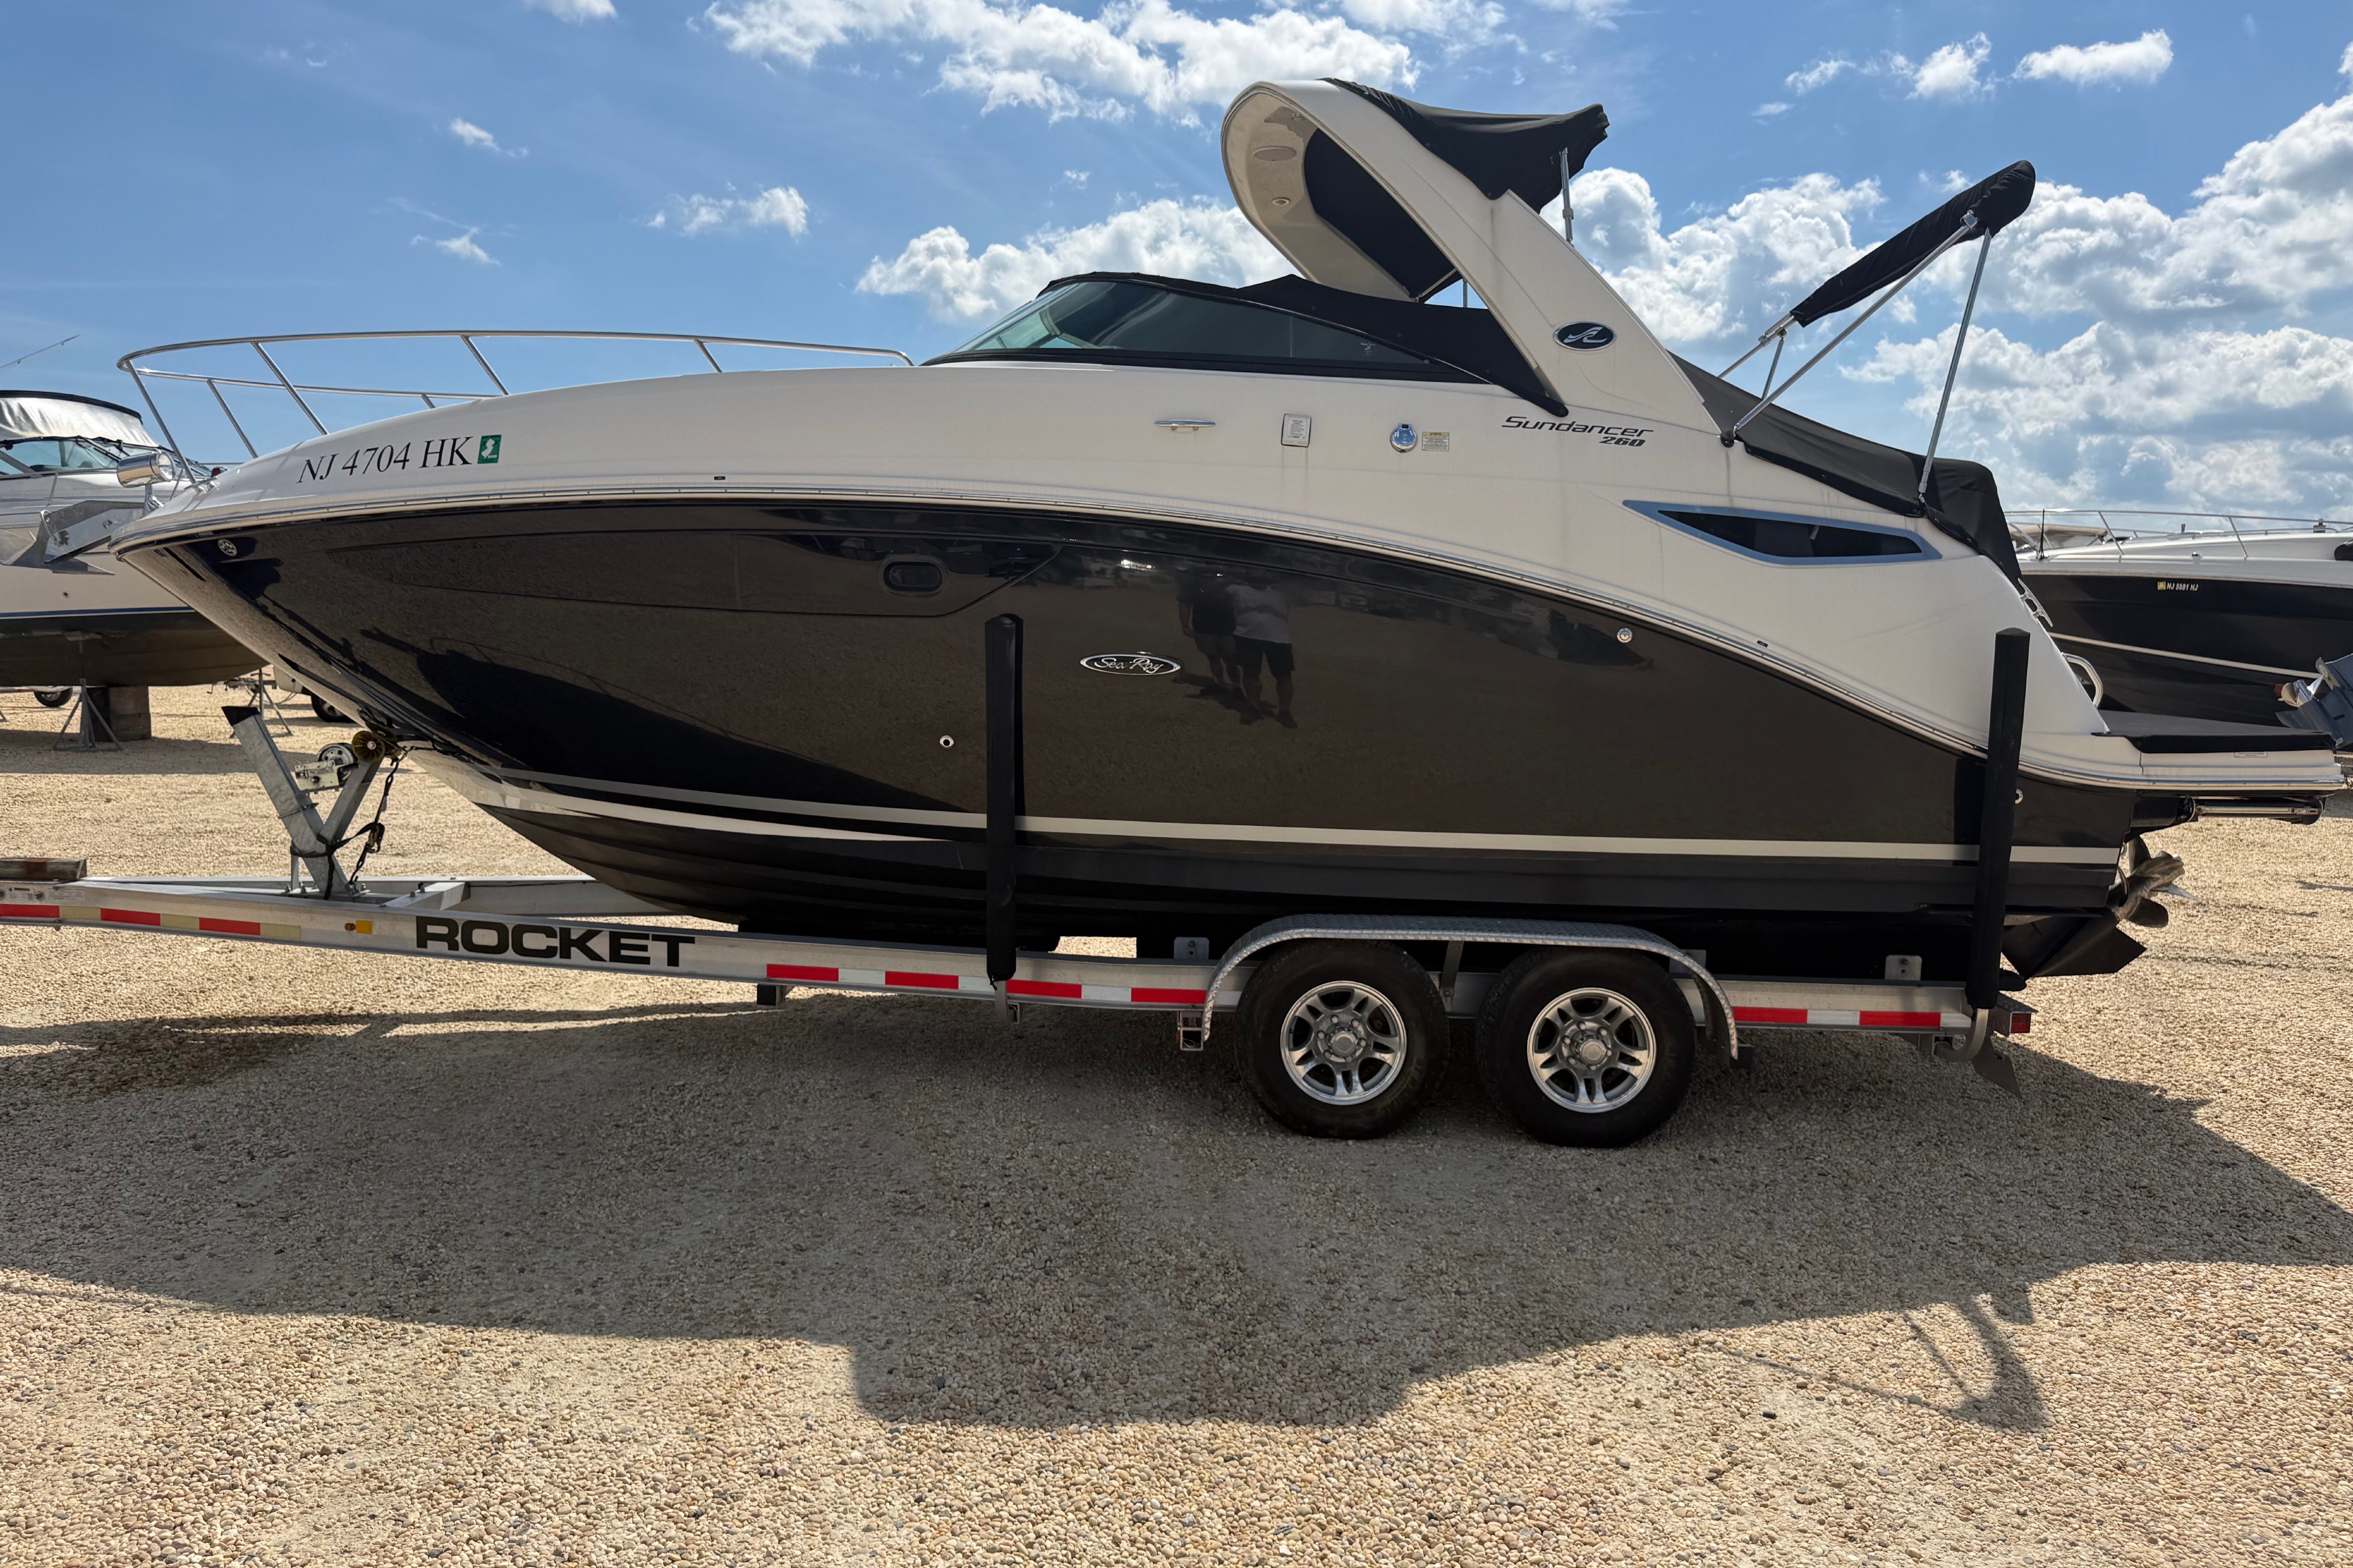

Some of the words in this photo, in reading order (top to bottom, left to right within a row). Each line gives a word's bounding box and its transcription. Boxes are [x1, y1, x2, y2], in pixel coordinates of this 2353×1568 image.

[1502, 416, 1653, 437] Sundancer
[1599, 436, 1645, 447] 260
[296, 453, 340, 484] NJ
[341, 442, 411, 476] 4704
[419, 436, 474, 469] HK
[1094, 657, 1127, 669] Sea
[1129, 658, 1164, 674] Ray
[415, 915, 696, 967] ROCKET
